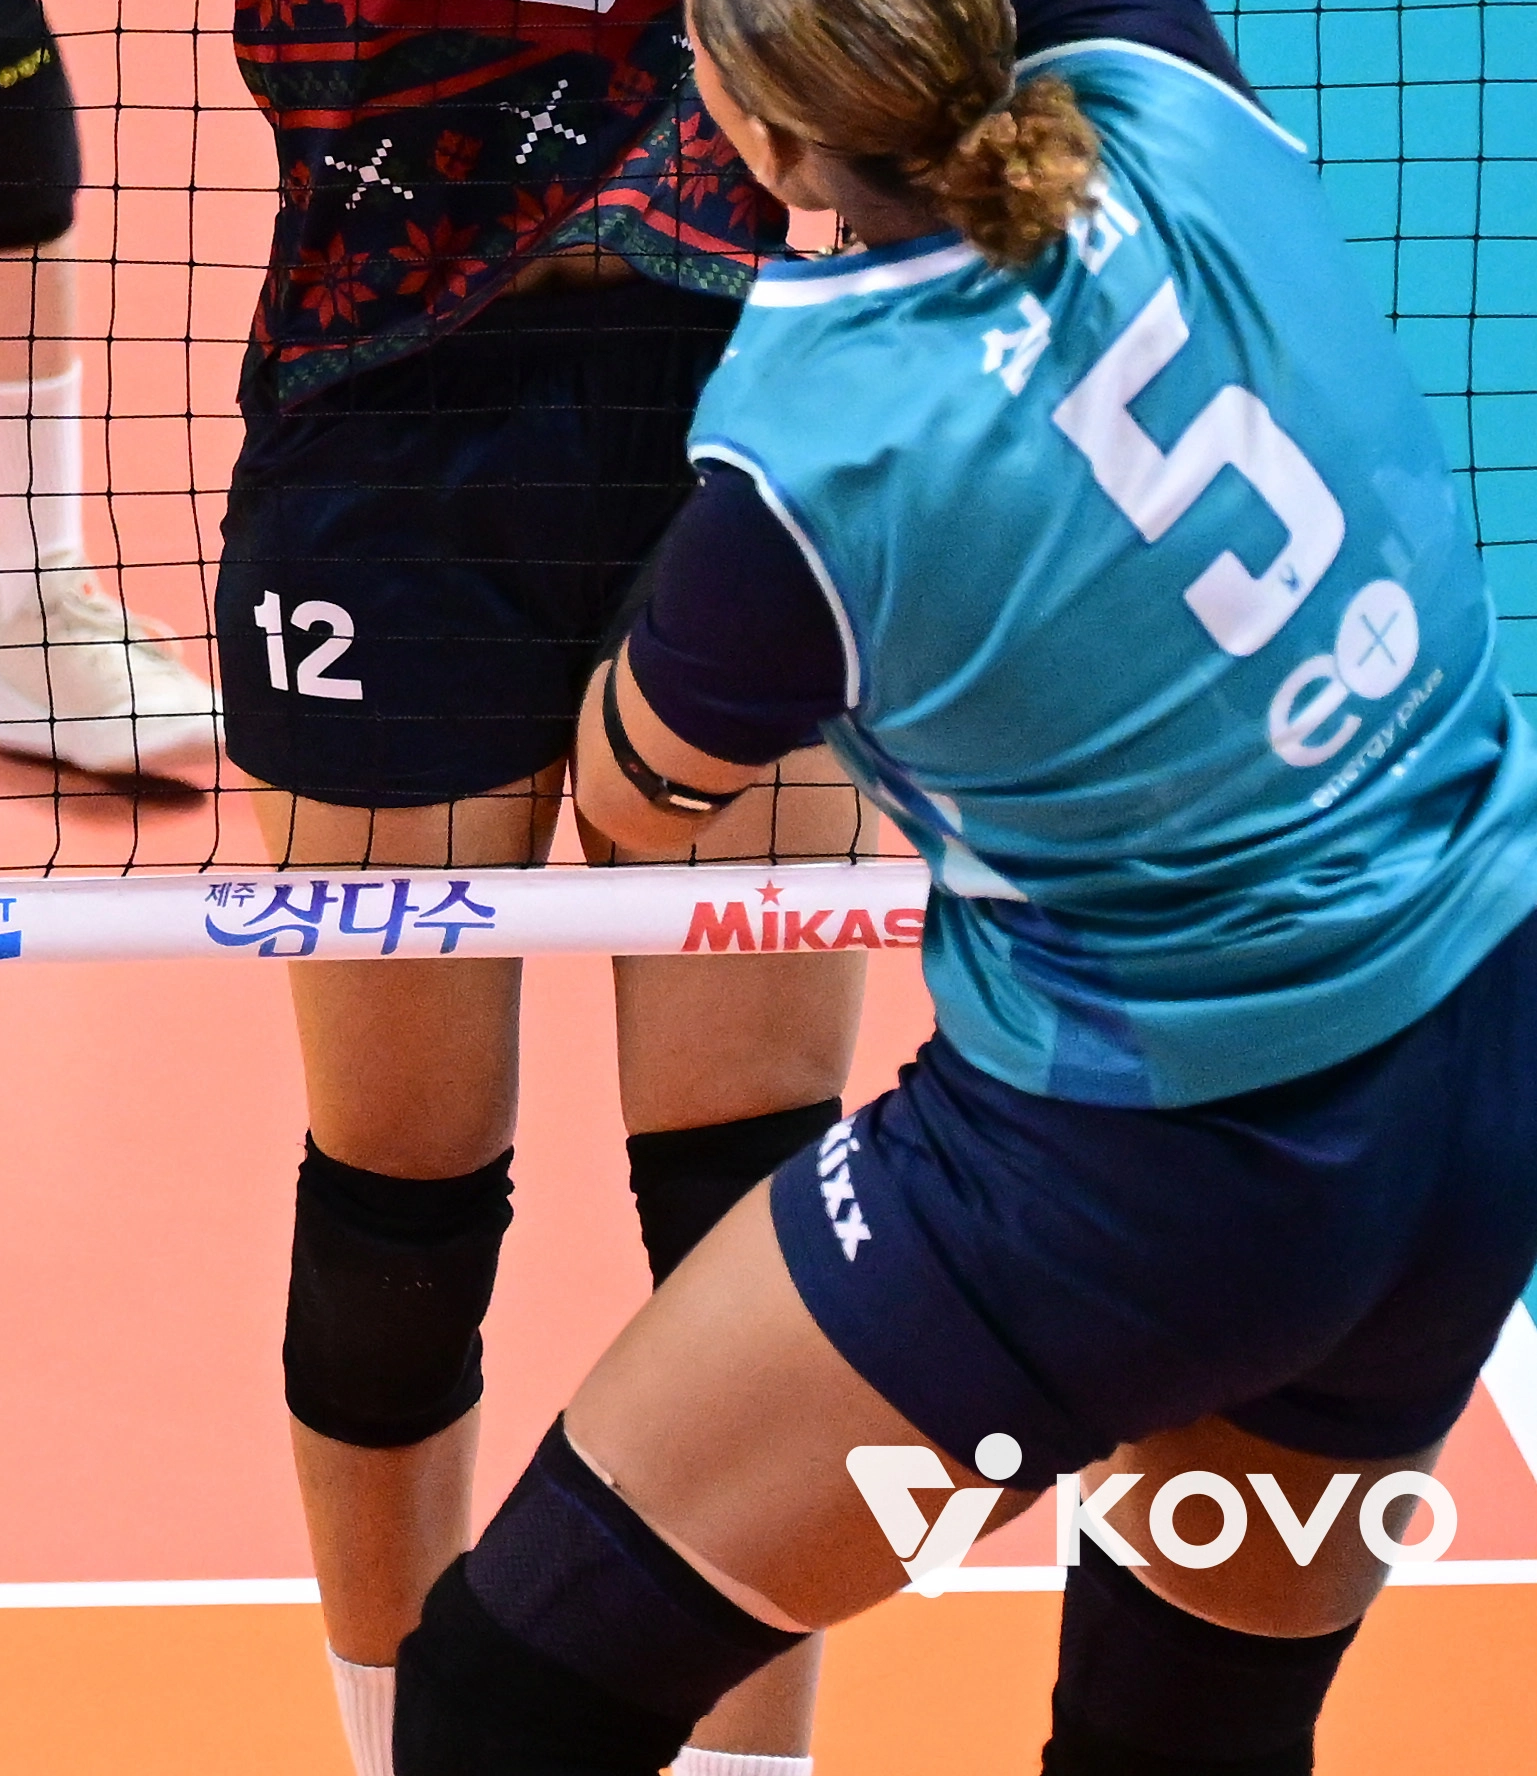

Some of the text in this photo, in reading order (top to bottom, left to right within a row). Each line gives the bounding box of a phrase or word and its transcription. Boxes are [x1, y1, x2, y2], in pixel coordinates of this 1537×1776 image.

[1051, 277, 1345, 658] 5
[254, 590, 364, 701] 12
[204, 878, 496, 957] 제주 삼다수
[681, 879, 926, 952] MIKAS
